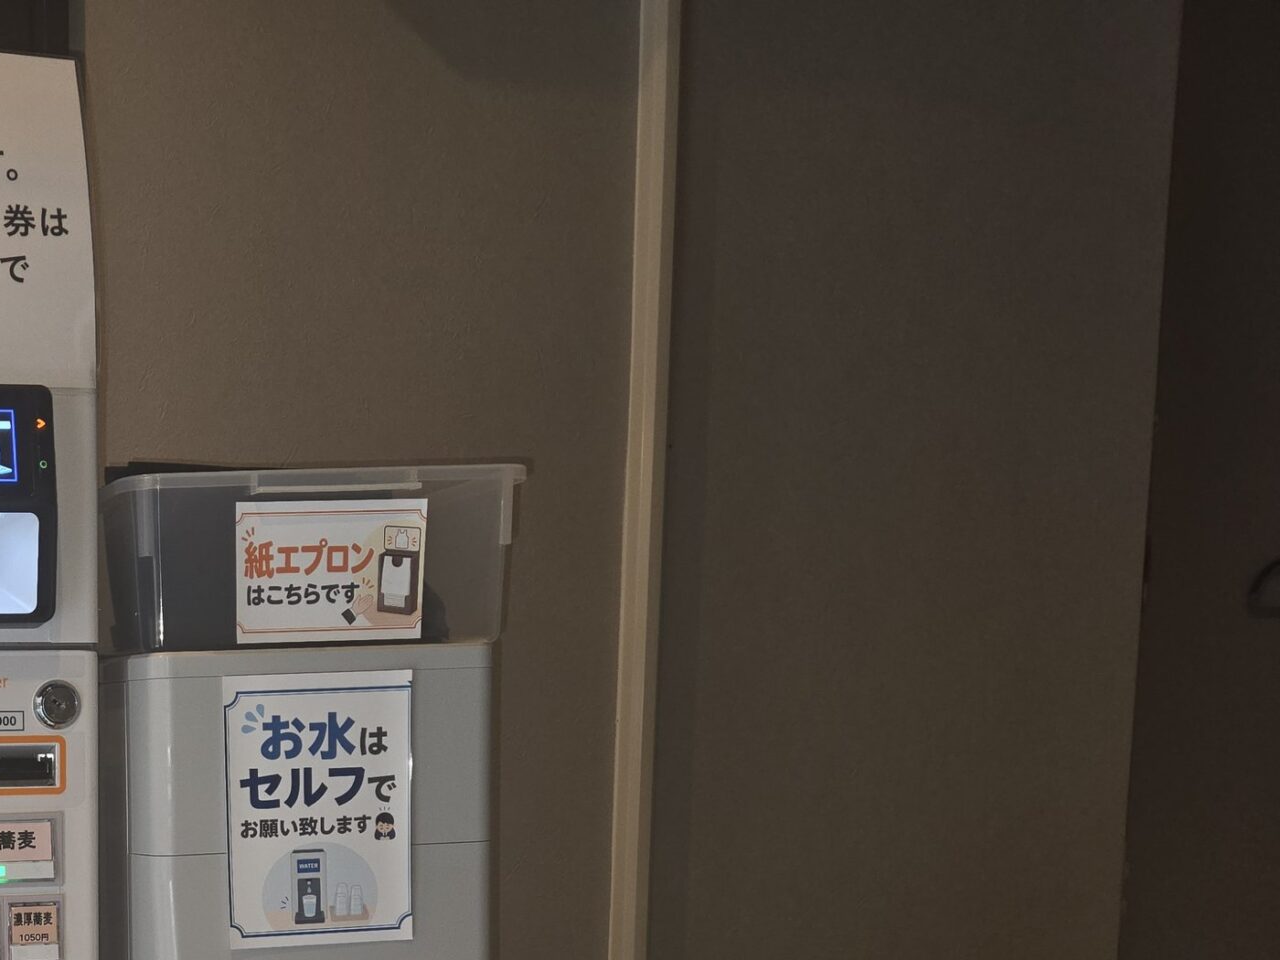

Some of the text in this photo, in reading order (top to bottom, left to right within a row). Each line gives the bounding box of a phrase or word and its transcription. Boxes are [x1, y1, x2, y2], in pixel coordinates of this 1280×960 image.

[244, 539, 375, 580] 紙エプロン
[246, 582, 360, 606] はこちらです
[260, 712, 388, 760] お水は
[239, 766, 397, 810] セルフで
[240, 814, 372, 839] お願い致します
[13, 912, 53, 926] 濃厚蕎麦
[19, 933, 49, 942] 1050円
